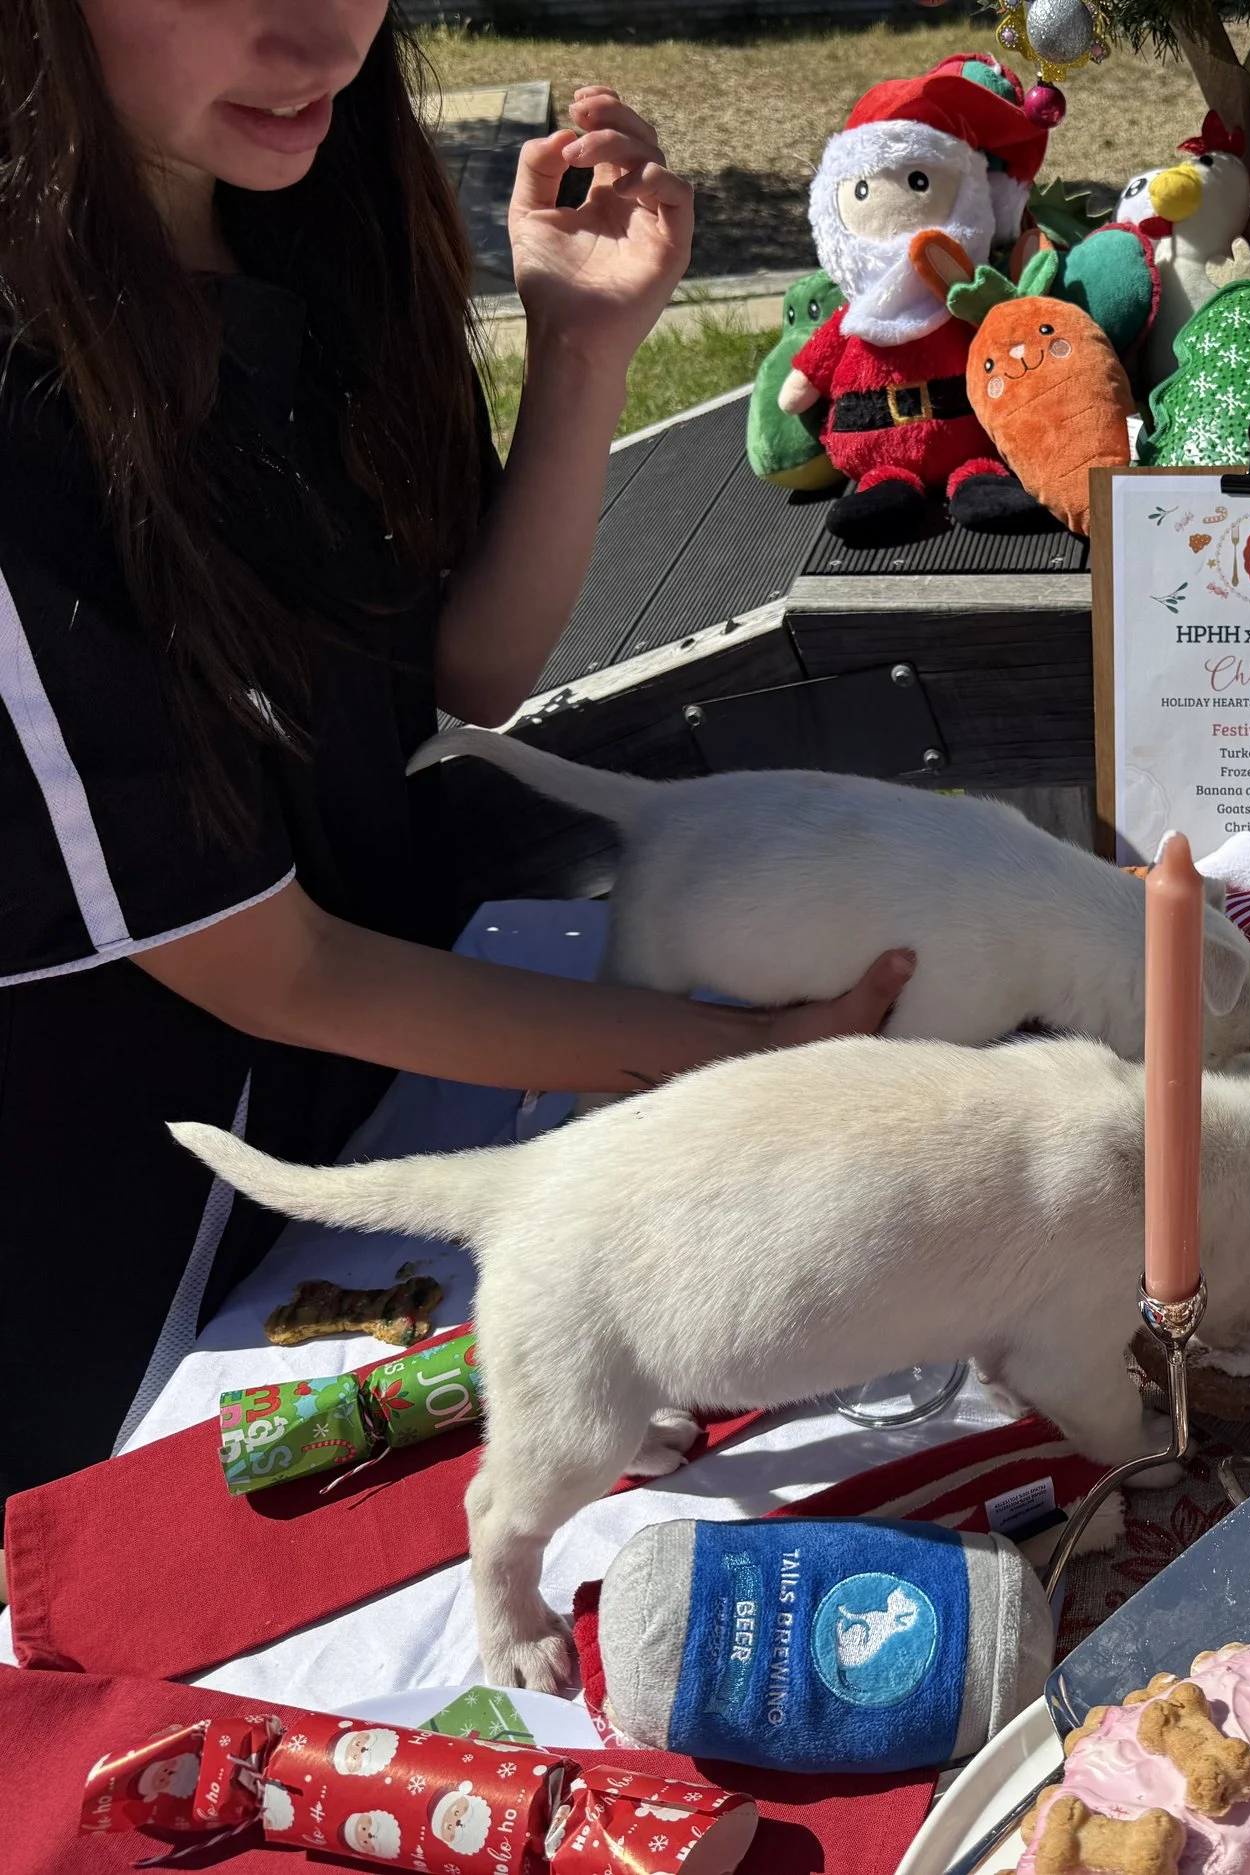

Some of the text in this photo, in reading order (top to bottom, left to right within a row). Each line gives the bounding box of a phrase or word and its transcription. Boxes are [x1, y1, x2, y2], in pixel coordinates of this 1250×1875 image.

[1176, 625, 1241, 643] HPHH
[1161, 698, 1210, 708] HOLIDAY
[1196, 785, 1243, 796] Banana
[1217, 804, 1250, 815] Goats
[417, 1368, 480, 1429] JOY
[730, 1601, 756, 1662] BEER
[767, 1549, 801, 1725] TAILS BREWING
